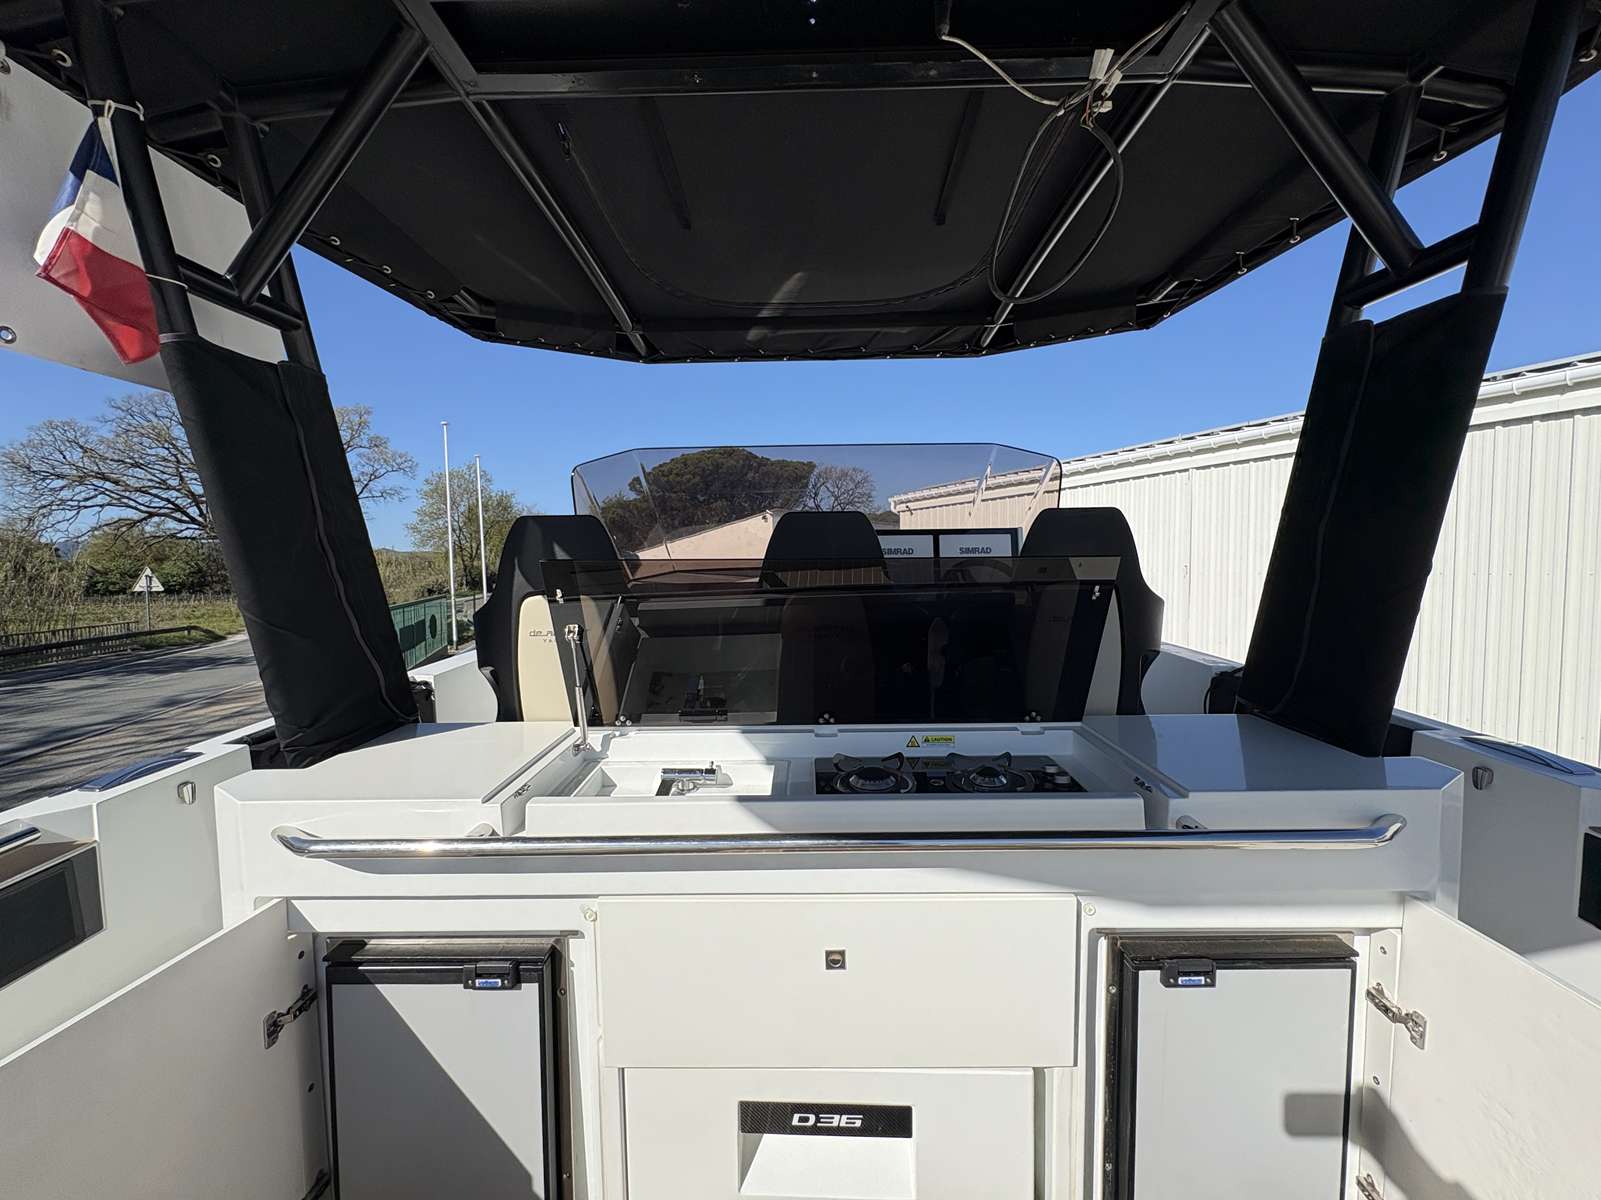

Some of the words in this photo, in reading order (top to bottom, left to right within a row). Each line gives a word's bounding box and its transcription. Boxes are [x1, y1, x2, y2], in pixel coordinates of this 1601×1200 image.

[882, 547, 914, 556] SIMRAD
[959, 546, 992, 555] SIMRAD
[791, 1113, 863, 1128] D36
